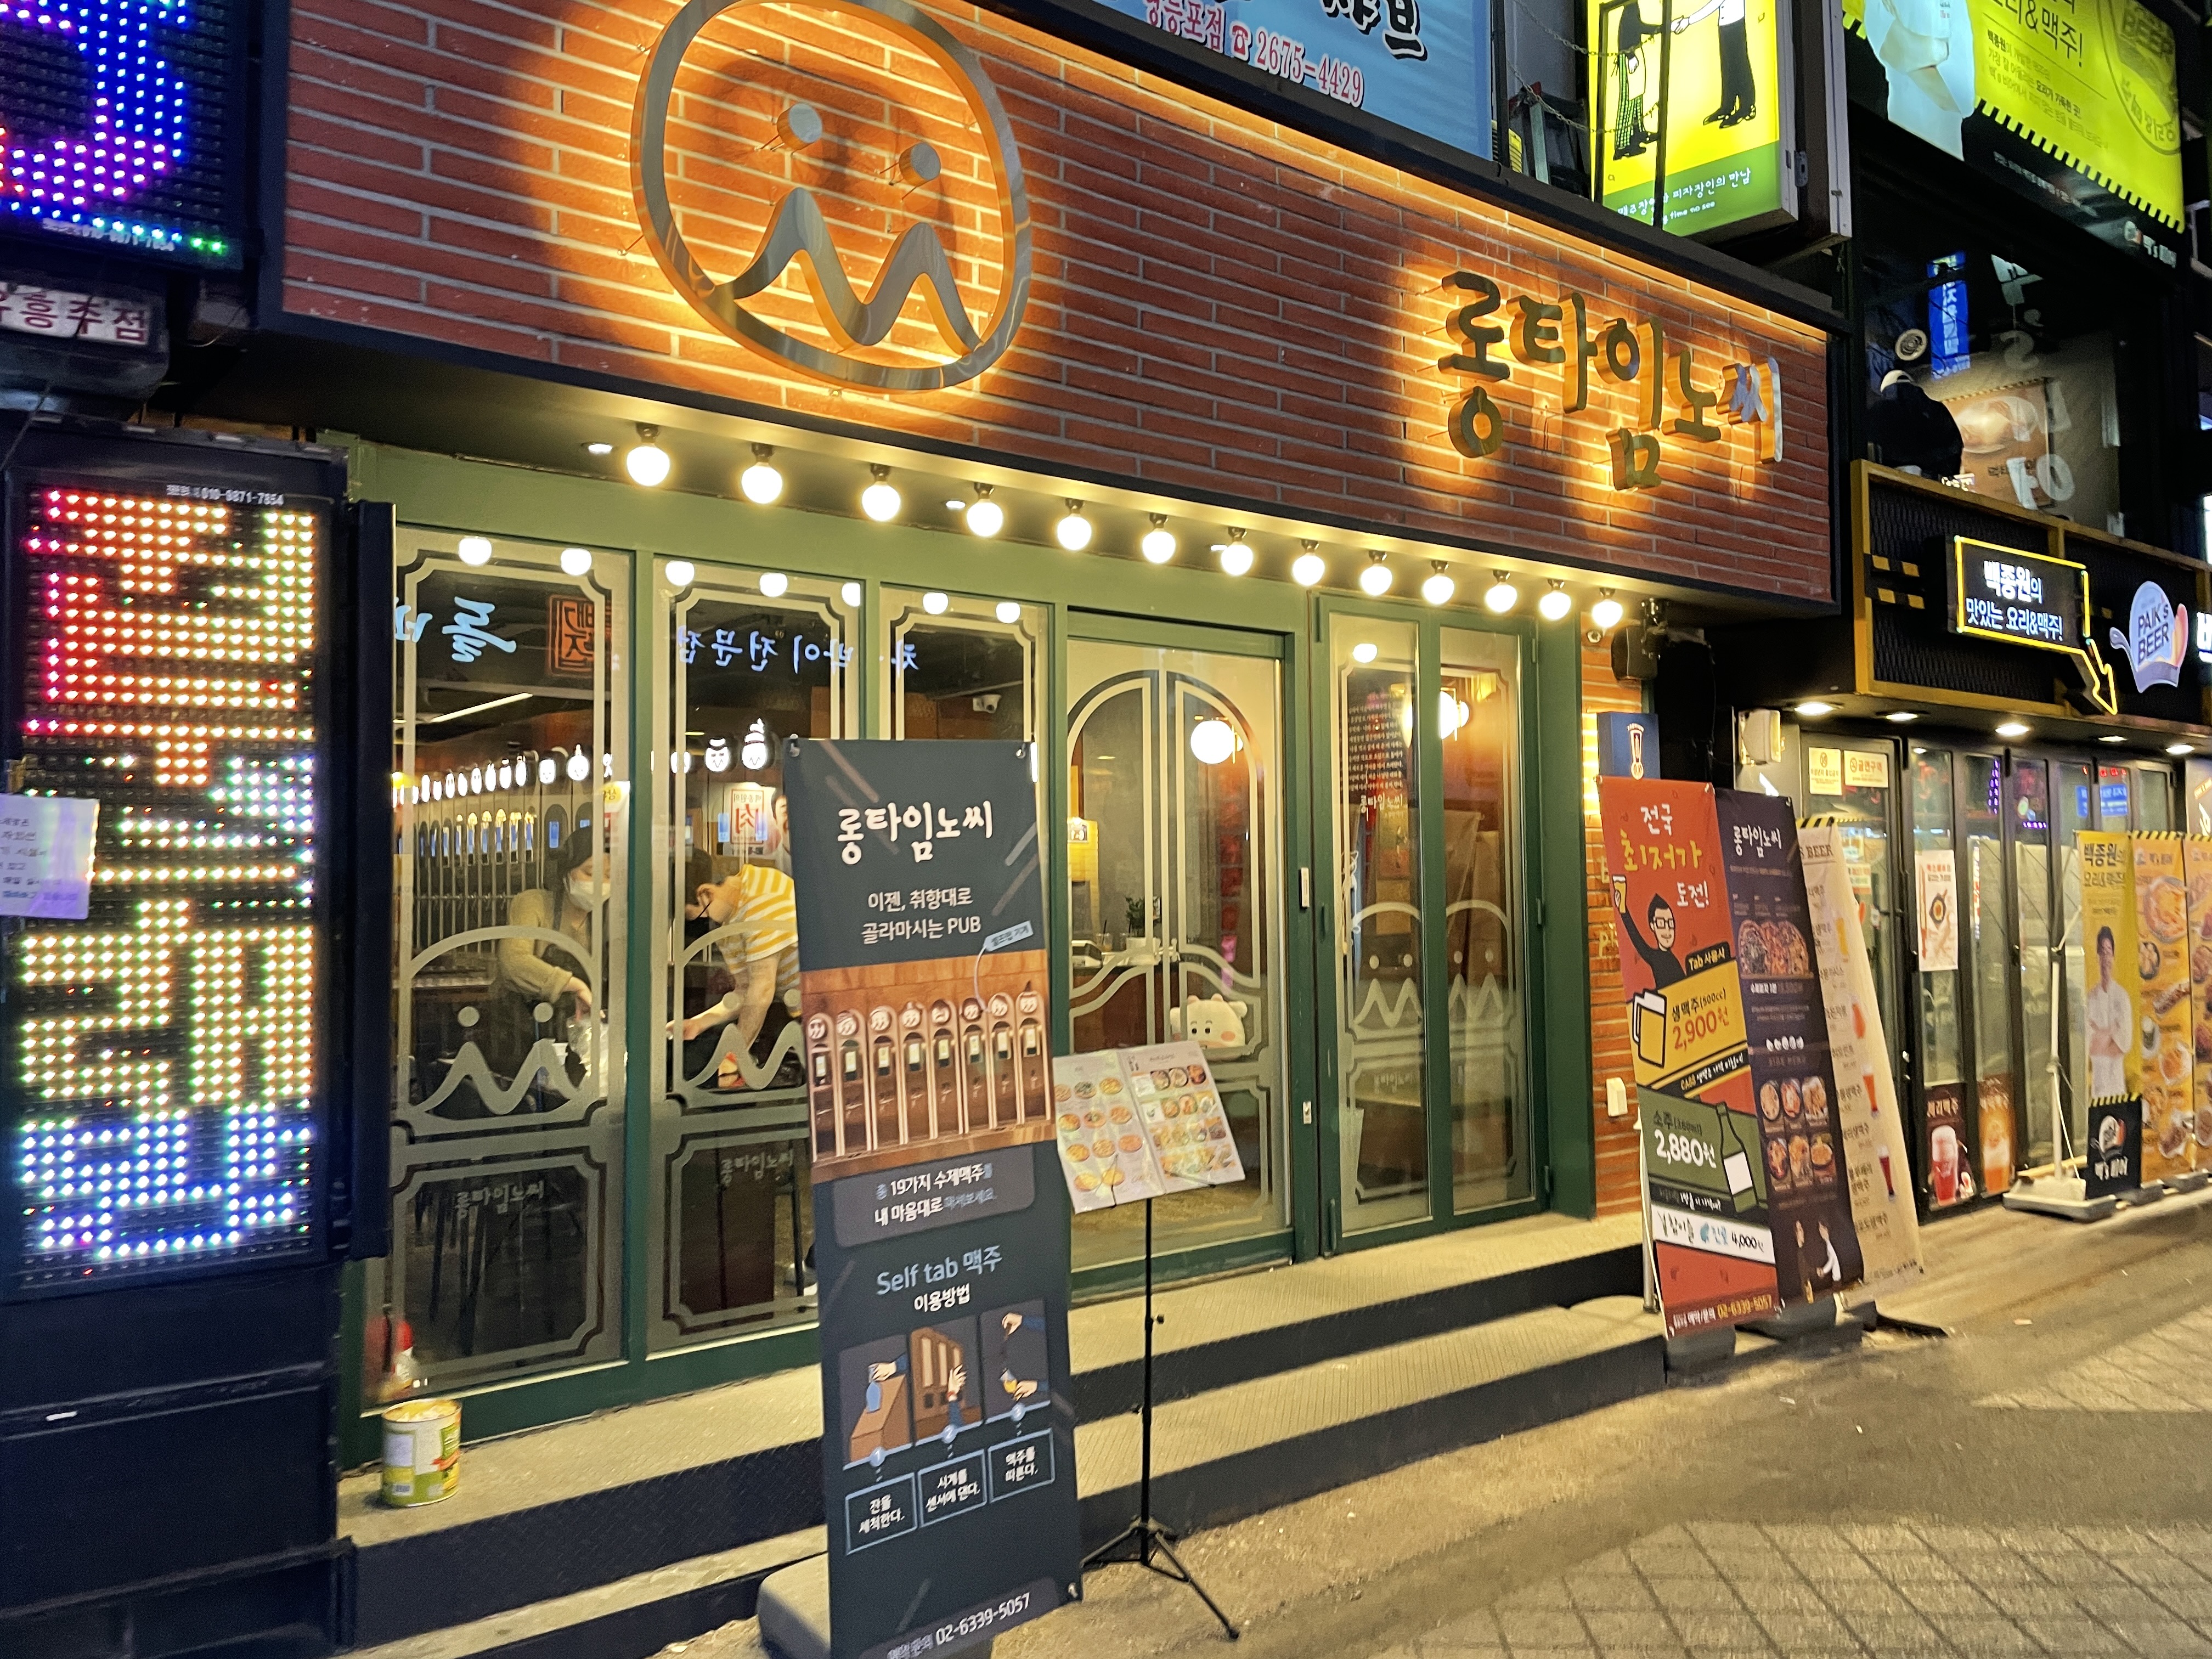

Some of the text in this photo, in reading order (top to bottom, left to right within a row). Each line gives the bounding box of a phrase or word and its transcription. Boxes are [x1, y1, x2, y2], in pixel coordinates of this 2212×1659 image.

[1993, 0, 2083, 67] 리&맥주!
[1256, 30, 1363, 106] 2675-4429
[1672, 174, 1726, 199] 피자장인의
[1729, 167, 1752, 188] 만남
[1670, 200, 1716, 219] time no see
[1437, 270, 1784, 491] 롱타임노씨
[1983, 558, 2043, 605] 백종원의
[1965, 596, 2064, 642] 맛있는 요리&맥주!
[2137, 622, 2170, 665] BEER
[837, 800, 994, 865] 롱타임노씨
[1640, 803, 1673, 836] 전국
[1620, 828, 1703, 872] 최저가
[1733, 825, 1782, 857] 롱타임노씨
[1807, 844, 1835, 859] BEER
[867, 887, 973, 912] 이젠, 취향대로
[1677, 880, 1710, 909] 도전!
[862, 916, 981, 944] 골라마시는 PUB
[1689, 953, 1704, 971] Tab
[1672, 1006, 1730, 1051] 2,900원
[1654, 1128, 1717, 1169] 2,880원
[890, 1173, 932, 1197] 19가지
[874, 1206, 889, 1227] 내
[891, 1196, 944, 1222] 마음대로
[877, 1244, 1002, 1296] Self tab 맥주
[913, 1283, 971, 1312] 이용방법
[1005, 1446, 1036, 1466] 맥주를
[870, 1493, 892, 1515] 잔을
[935, 1592, 1031, 1646] 02-6339-5057
